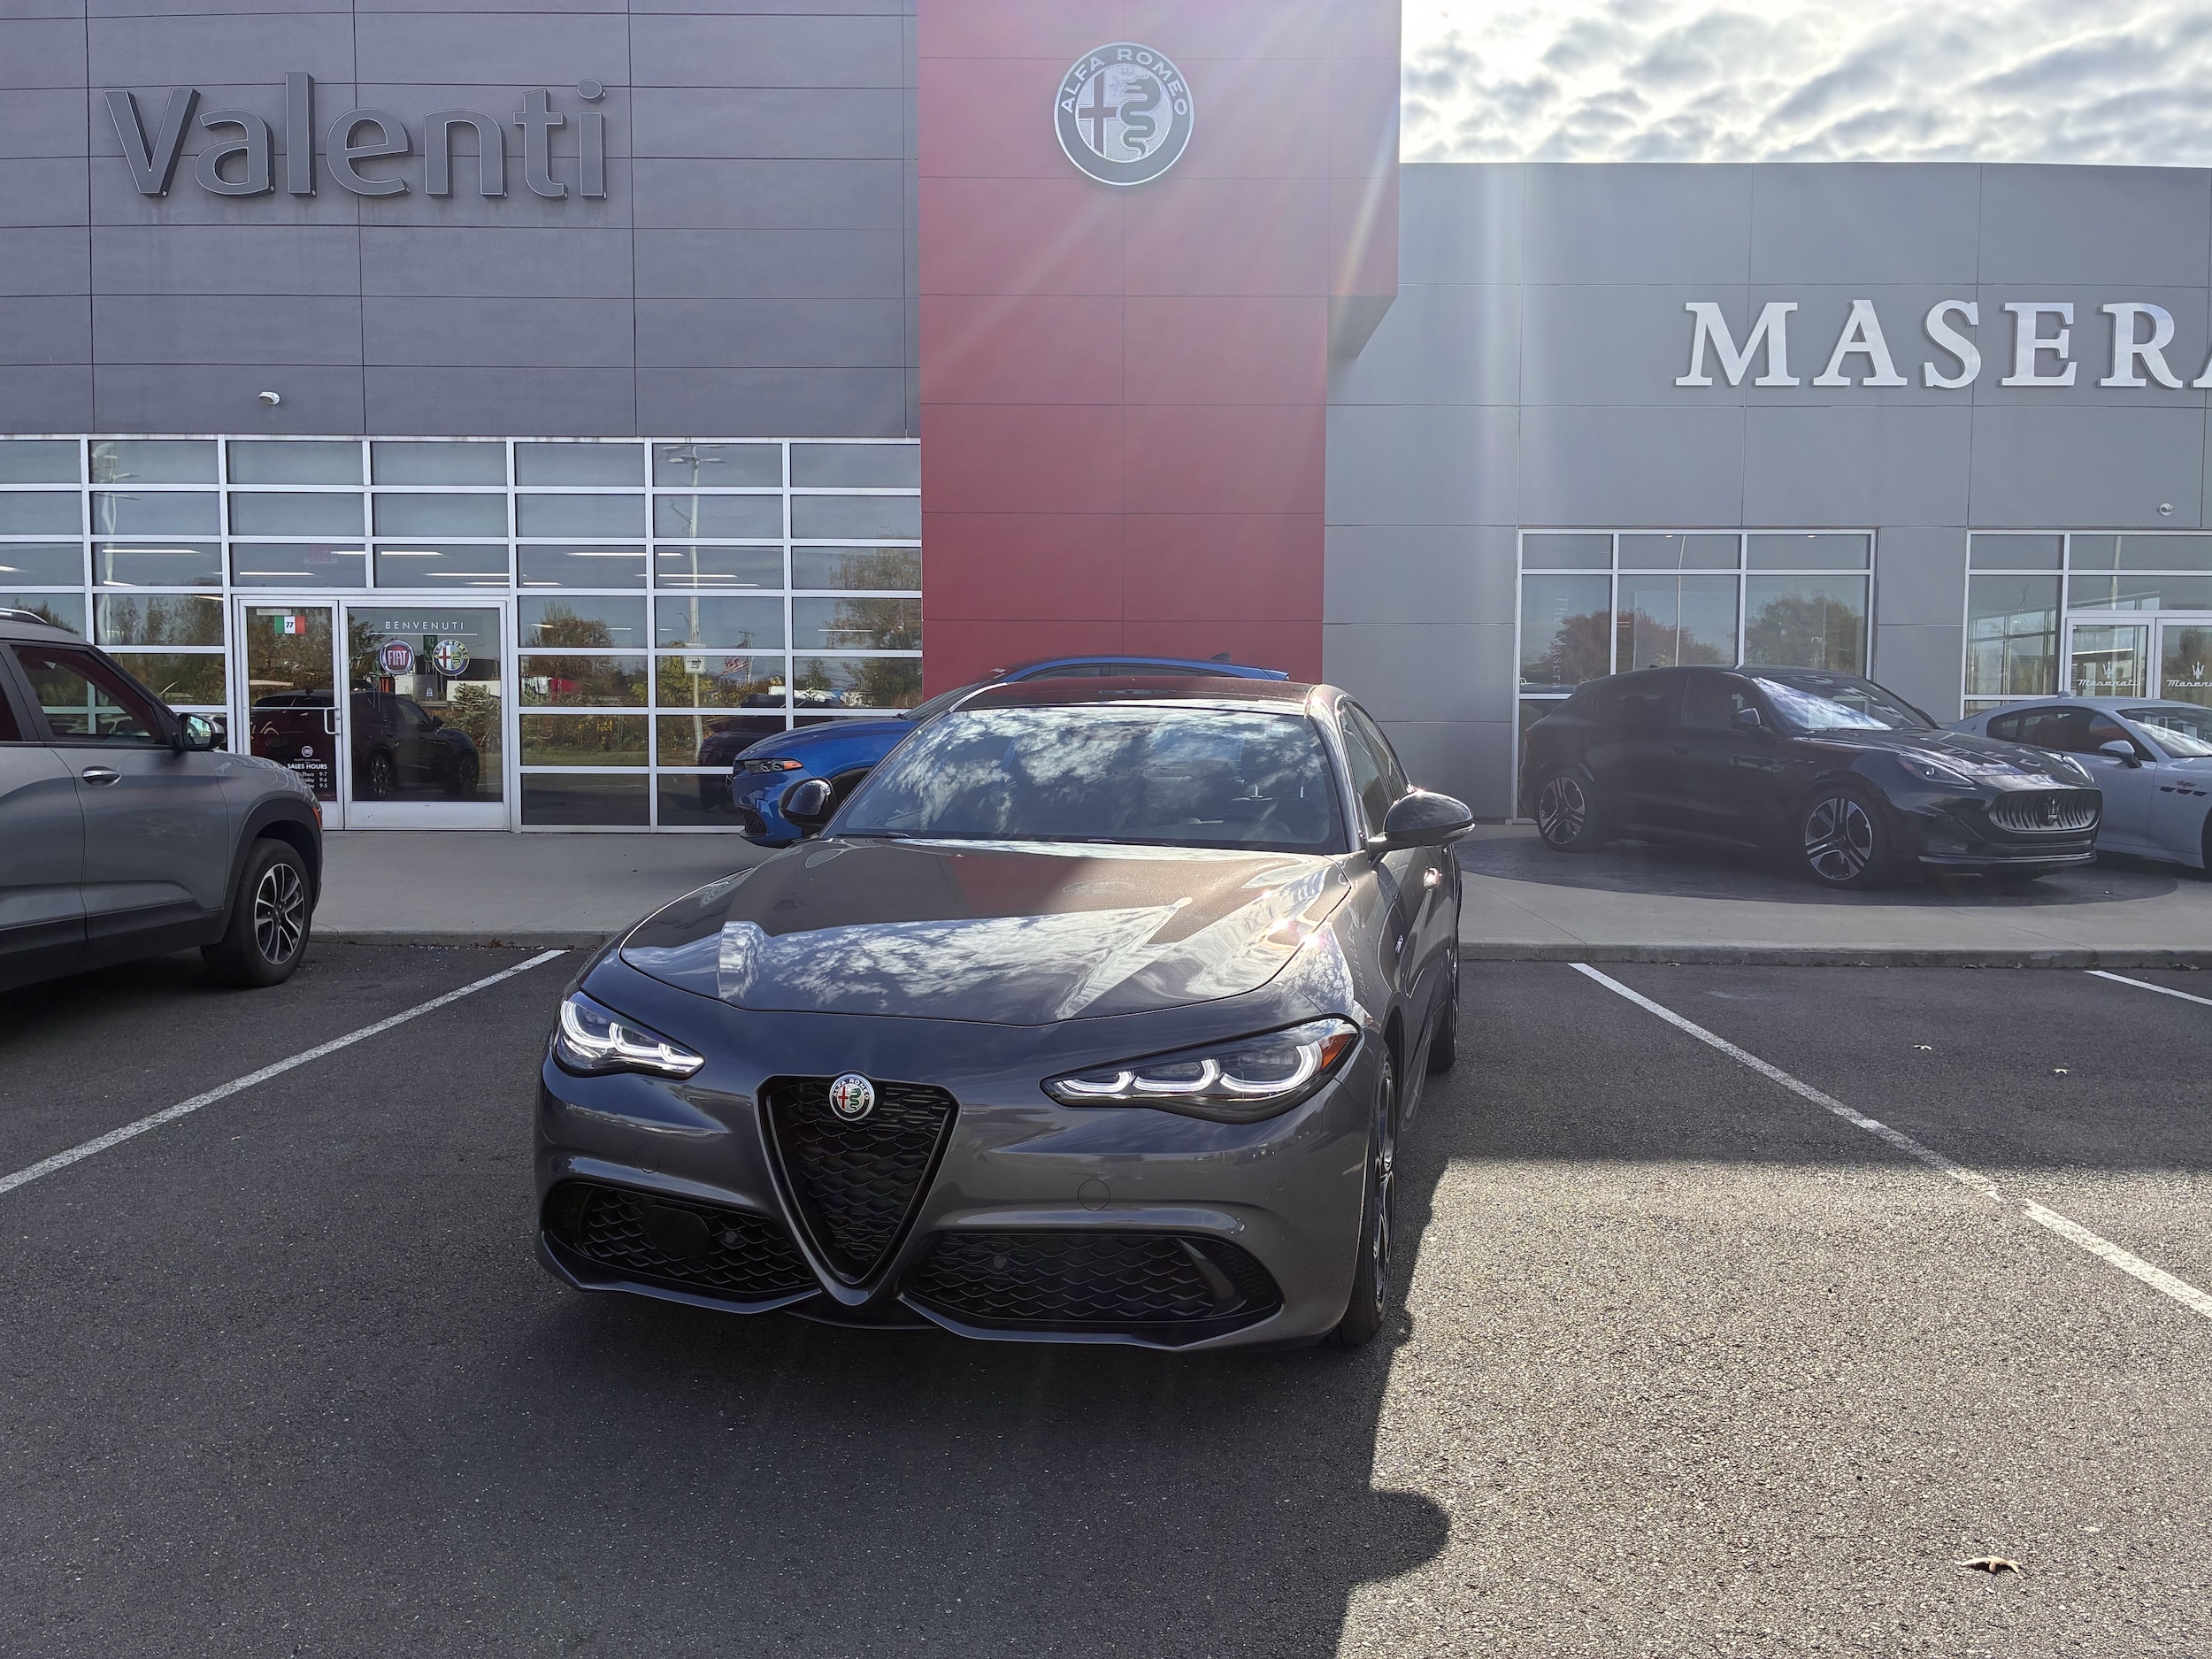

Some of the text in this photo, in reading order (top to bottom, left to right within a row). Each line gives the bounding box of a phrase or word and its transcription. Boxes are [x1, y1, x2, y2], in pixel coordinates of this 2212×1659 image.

[1061, 48, 1187, 115] ALFA ROMEO
[104, 72, 607, 198] Valenti
[385, 621, 464, 630] BENVENUTI
[388, 650, 407, 665] FIAT
[434, 640, 468, 659] ALFA ROMEO
[833, 1079, 870, 1100] ALFA ROMEO
